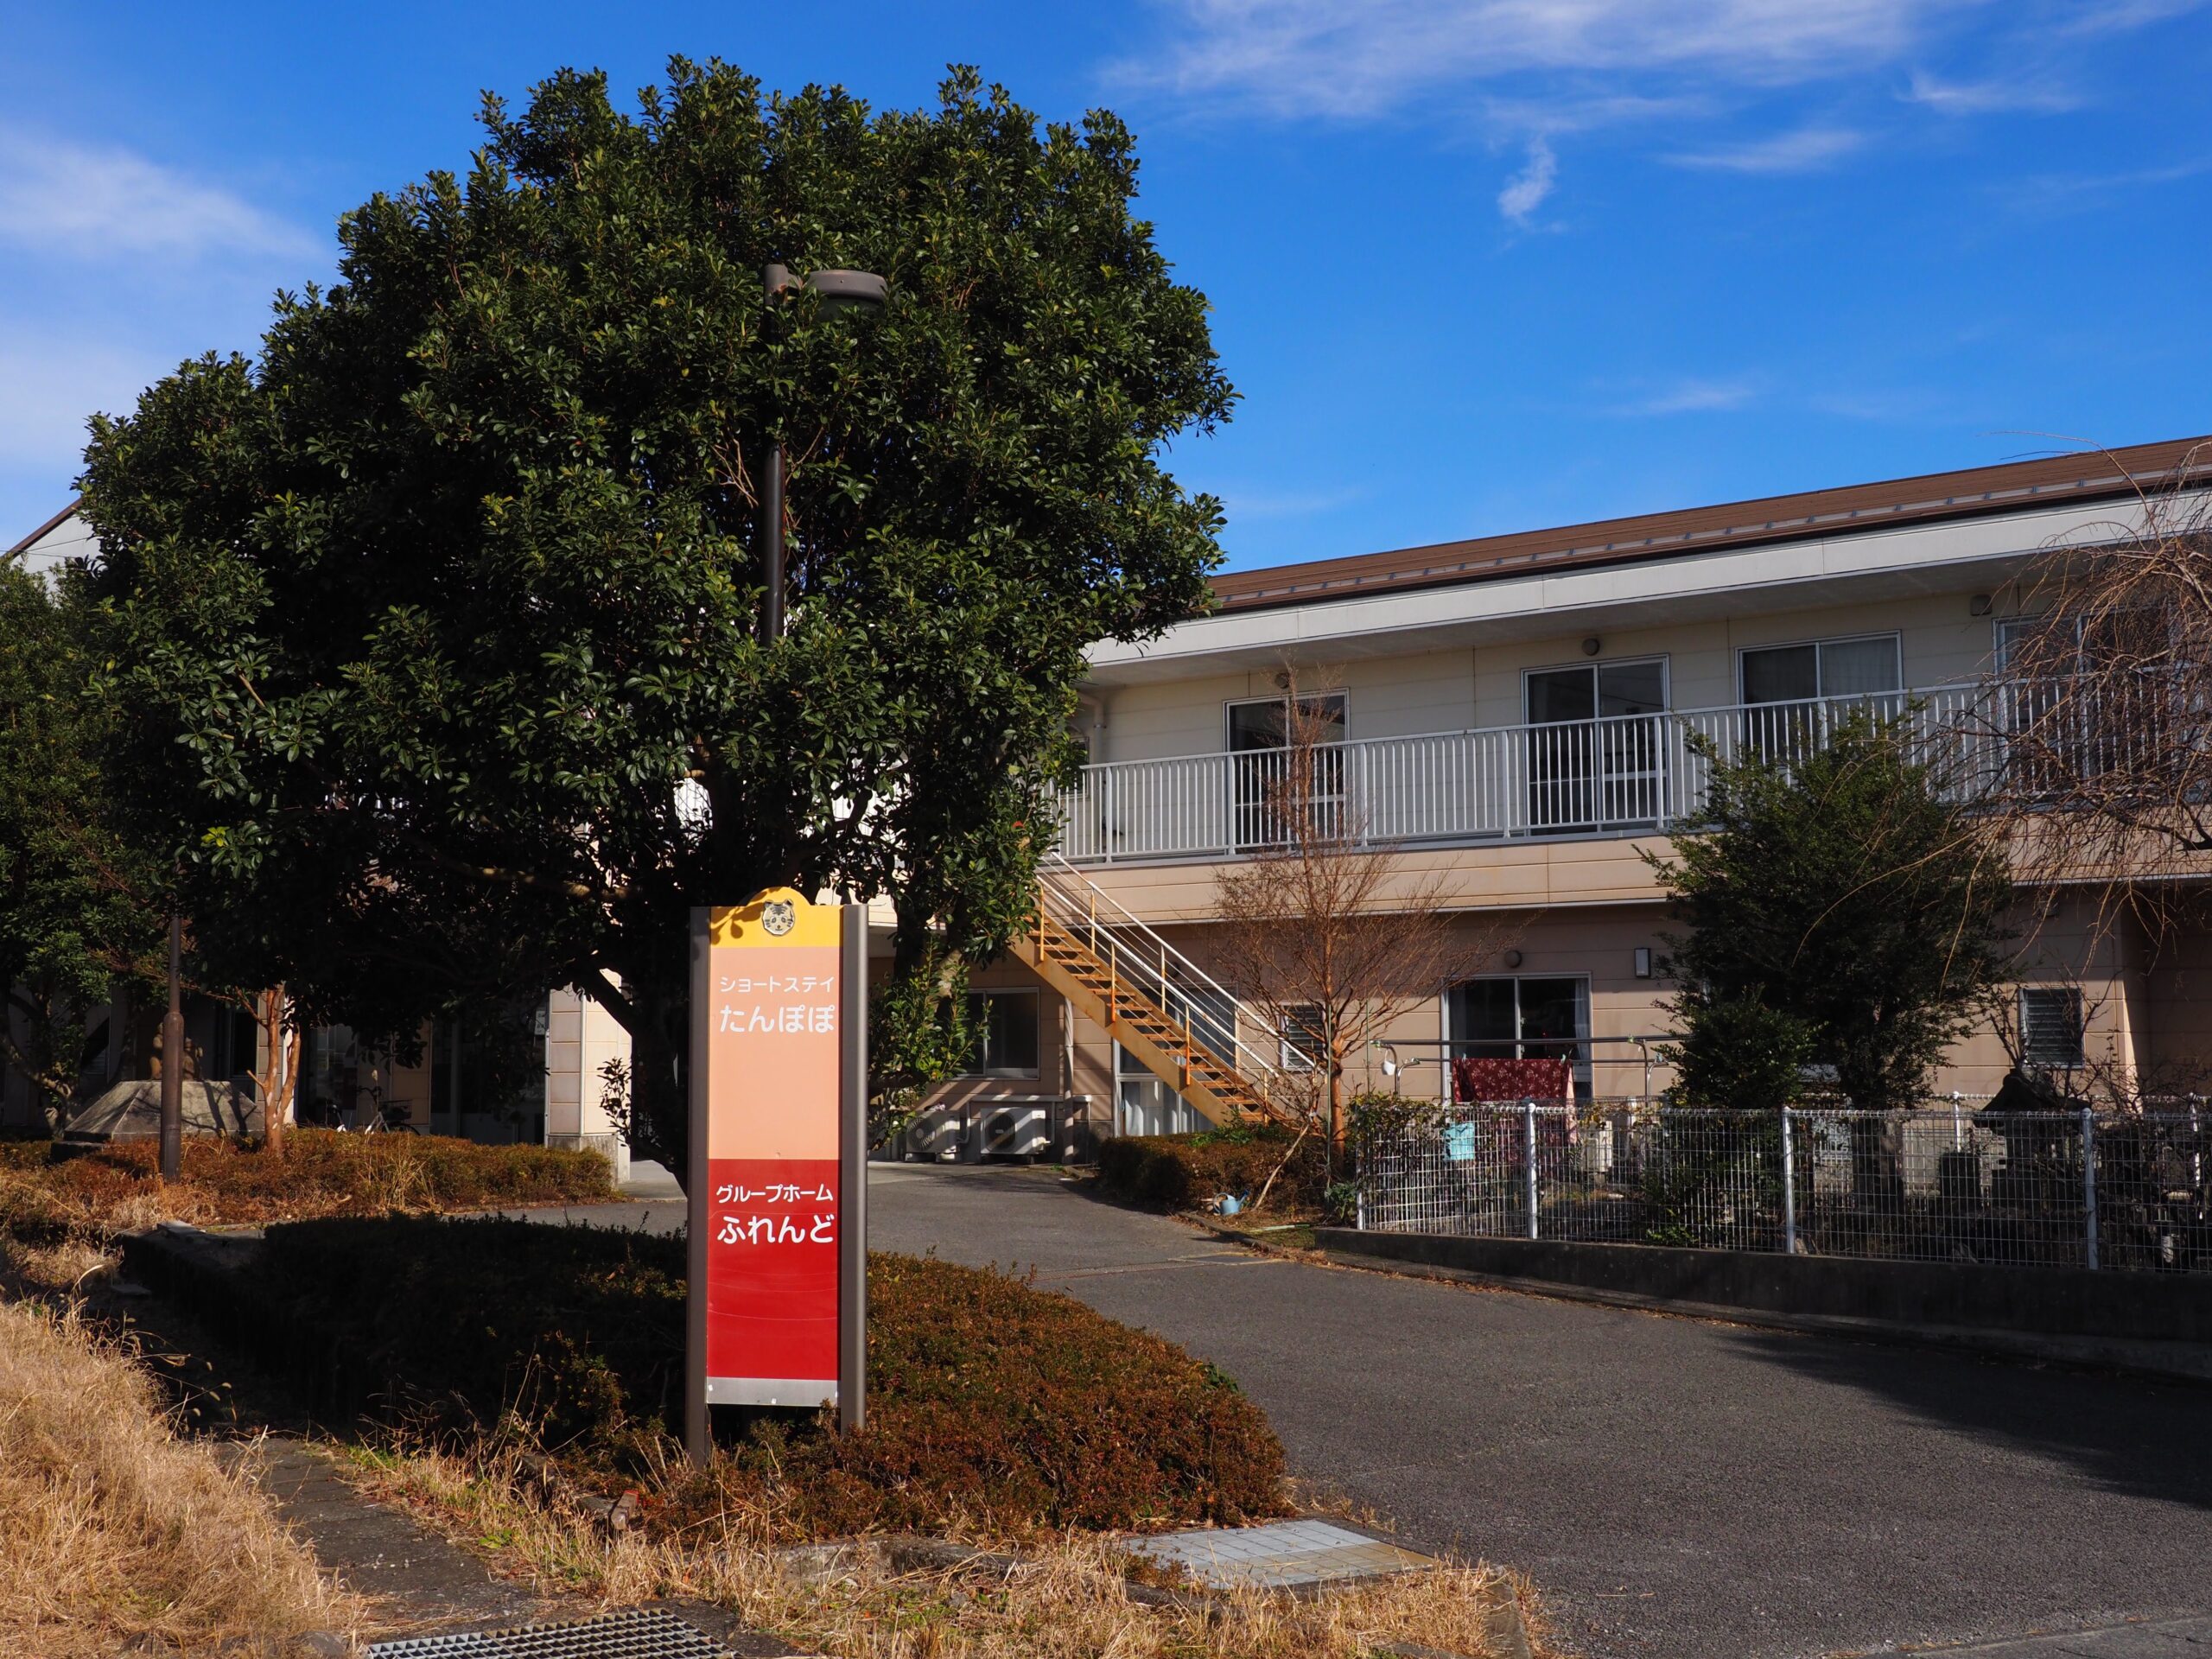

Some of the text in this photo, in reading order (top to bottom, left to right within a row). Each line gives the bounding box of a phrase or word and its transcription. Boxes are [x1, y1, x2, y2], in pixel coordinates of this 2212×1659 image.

[720, 976, 834, 993] ショートステイ
[720, 1004, 836, 1033] たんぽぽ
[716, 1184, 834, 1204] グループホーム
[717, 1214, 835, 1245] ふれんど
